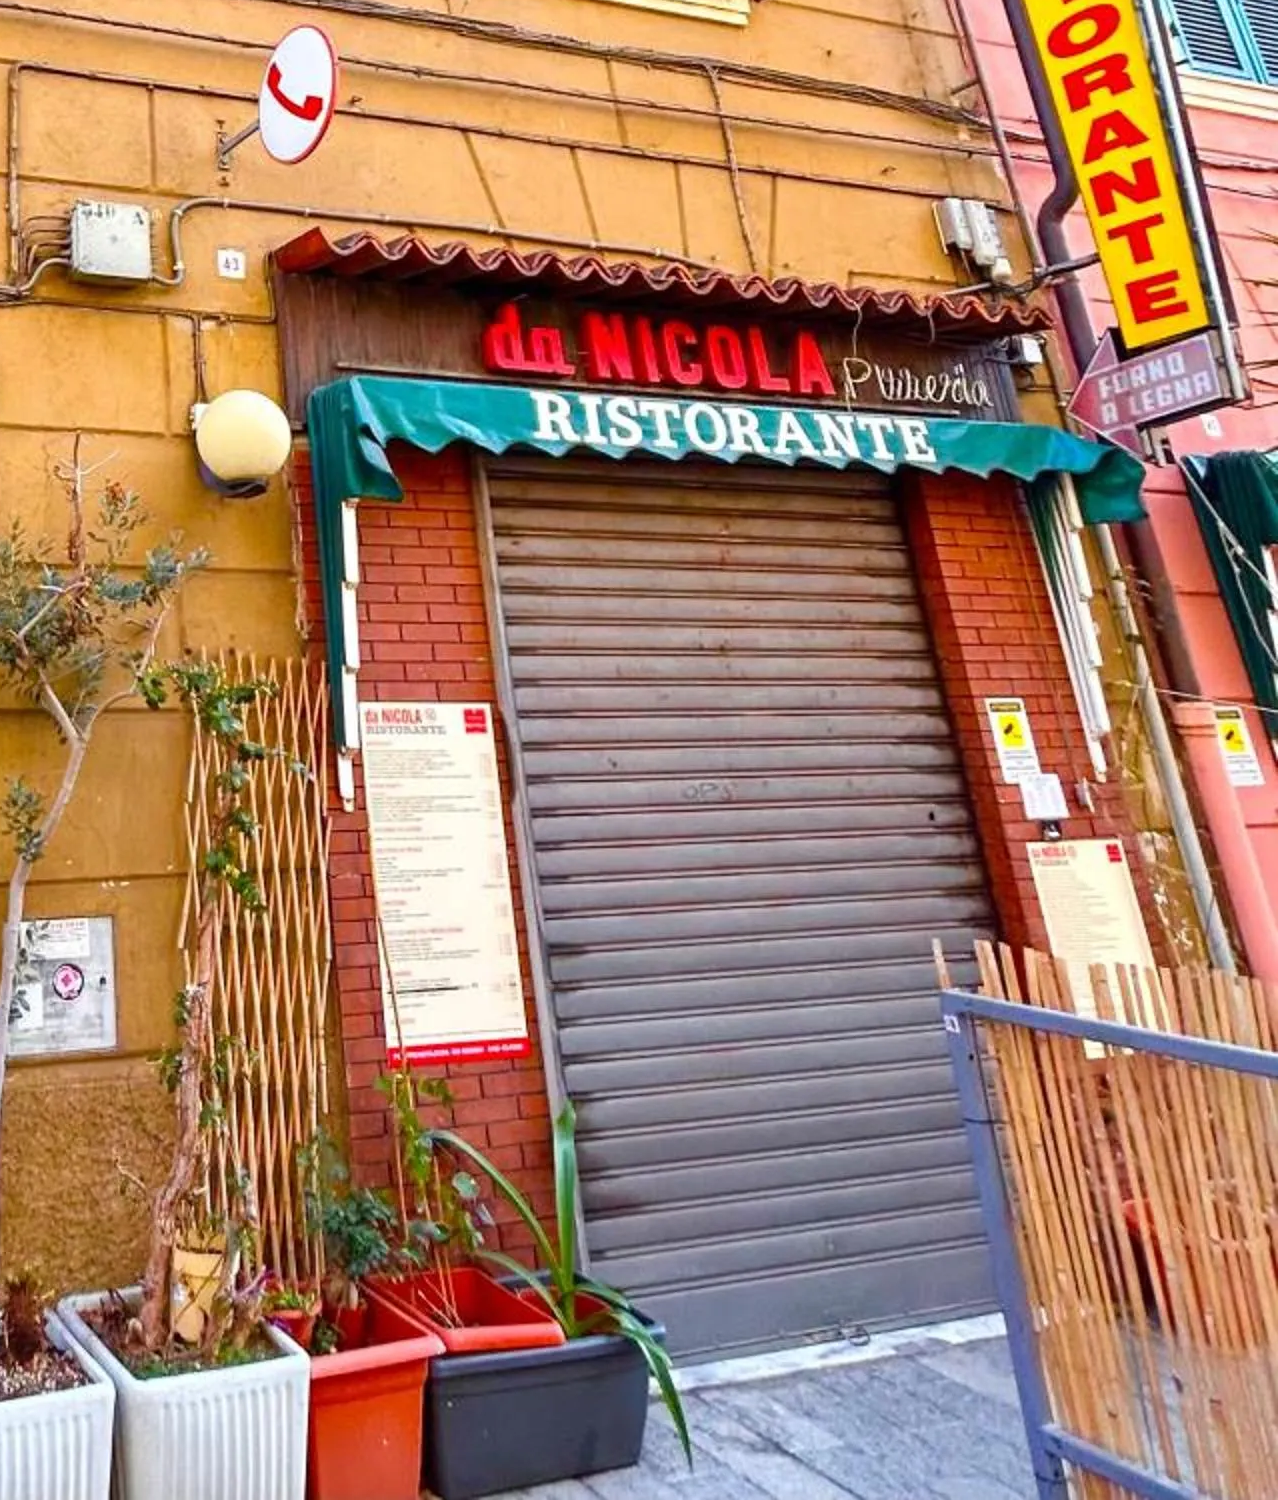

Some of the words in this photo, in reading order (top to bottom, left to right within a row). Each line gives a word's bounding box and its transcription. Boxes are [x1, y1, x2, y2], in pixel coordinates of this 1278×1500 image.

[484, 304, 576, 375] da
[581, 312, 836, 397] NICOLA
[1098, 351, 1185, 398] FORNO
[1102, 402, 1119, 425] A
[1129, 371, 1212, 416] LEGNA
[530, 390, 939, 463] RISTORANTE
[366, 725, 447, 735] RISTORANTE
[381, 708, 422, 724] NICOLA
